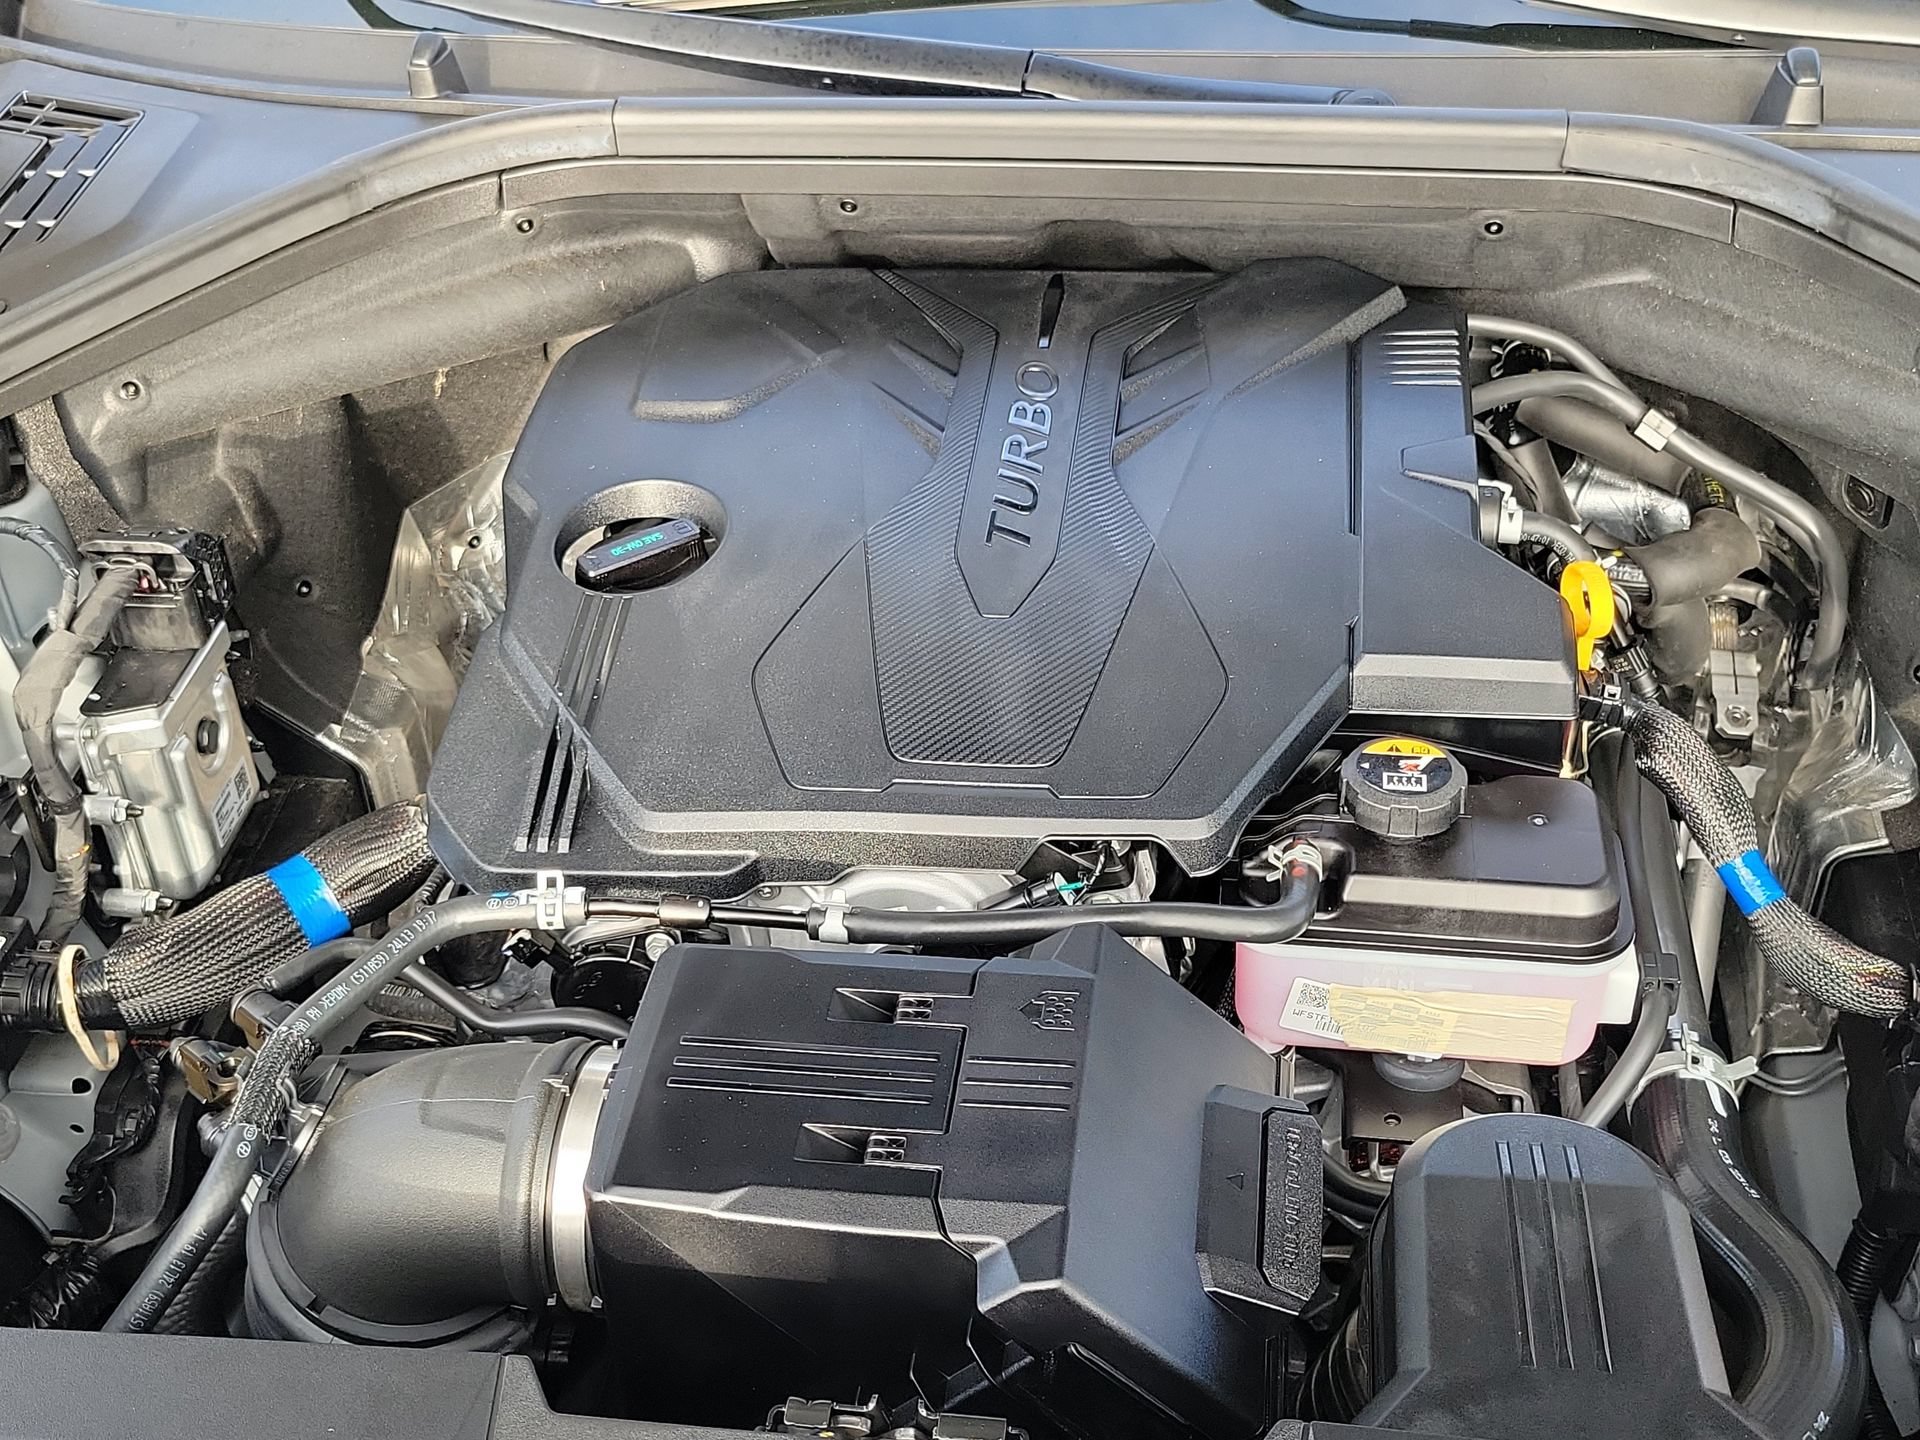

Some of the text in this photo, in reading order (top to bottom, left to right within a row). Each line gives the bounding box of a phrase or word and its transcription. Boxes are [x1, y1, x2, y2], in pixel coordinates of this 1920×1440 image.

[984, 360, 1059, 548] TURBO
[1704, 476, 1725, 504] HETA
[310, 1006, 323, 1020] PH
[388, 929, 415, 957] 24L13
[413, 910, 439, 937] 19:17
[158, 1260, 187, 1289] 24L13
[183, 1226, 209, 1257] 19:17
